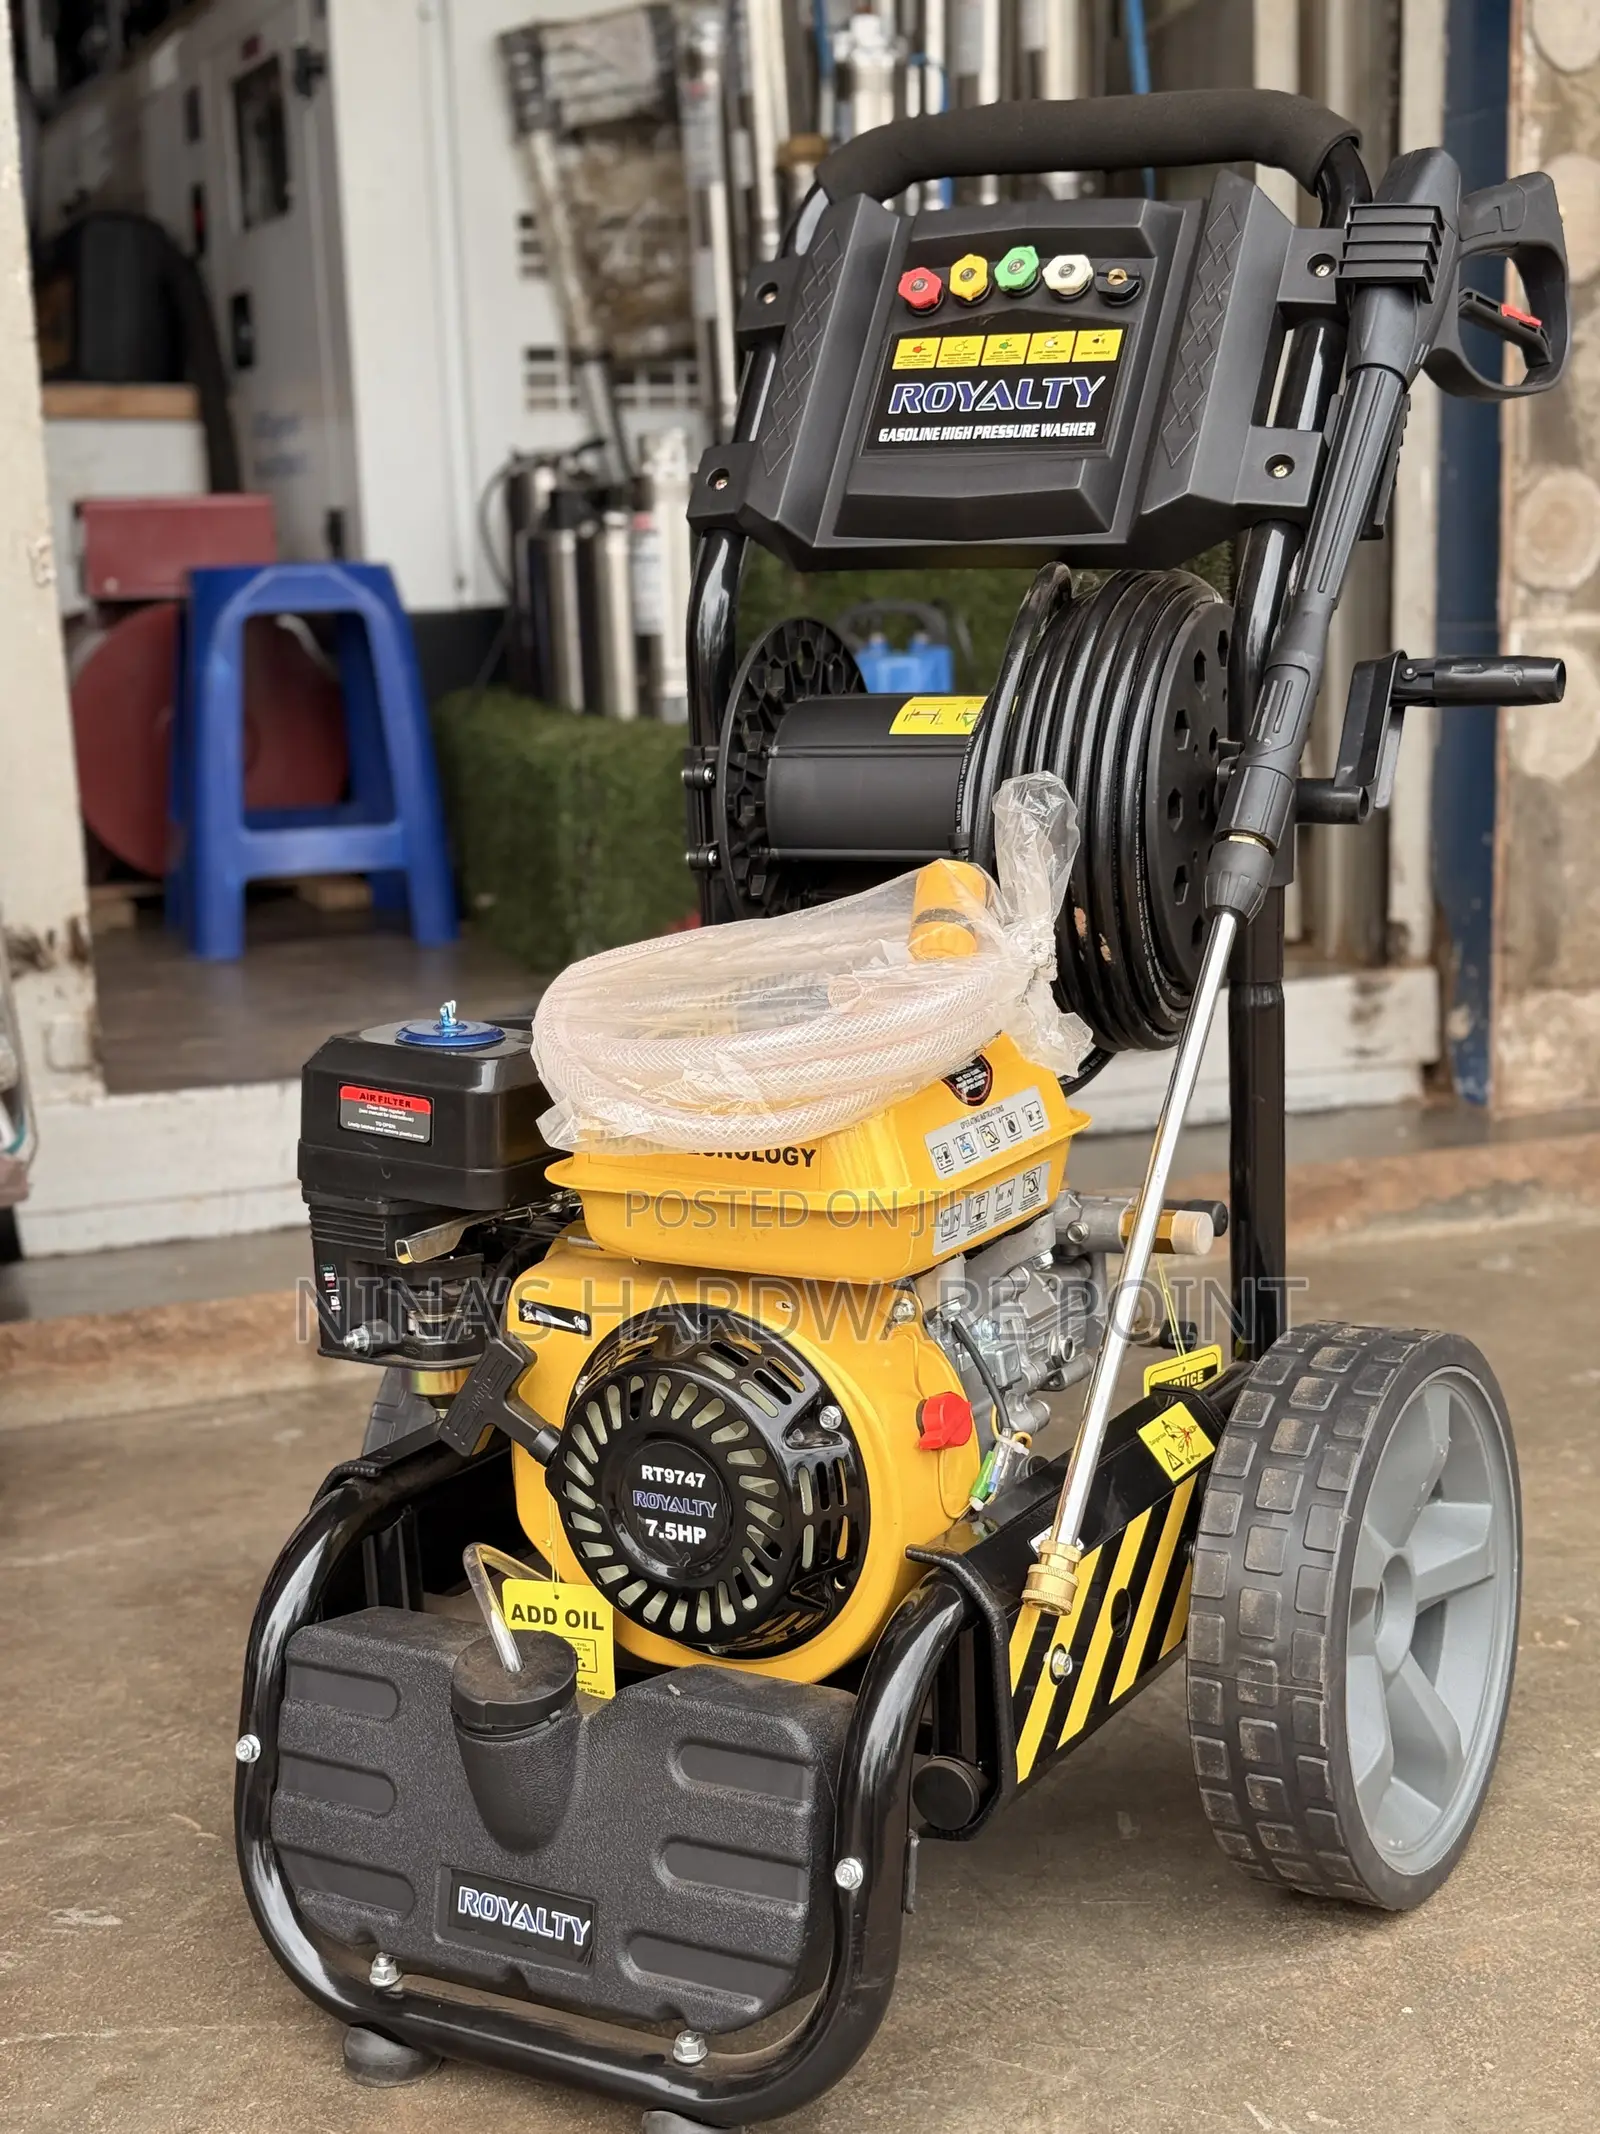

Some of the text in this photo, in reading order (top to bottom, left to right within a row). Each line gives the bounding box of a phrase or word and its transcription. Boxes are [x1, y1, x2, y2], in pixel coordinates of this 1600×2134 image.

[888, 375, 1106, 415] ROYALTY
[878, 421, 1096, 443] GASOLINE HIGH PRESSURE WASHER
[360, 1092, 411, 1108] AIR FILTER
[1166, 1369, 1204, 1387] OTICE
[641, 1464, 706, 1488] RT9747
[632, 1489, 717, 1518] ROYALTY
[645, 1518, 707, 1544] 7.5HP
[511, 1603, 604, 1631] ADD OIL
[458, 1885, 591, 1946] ROYALTY
